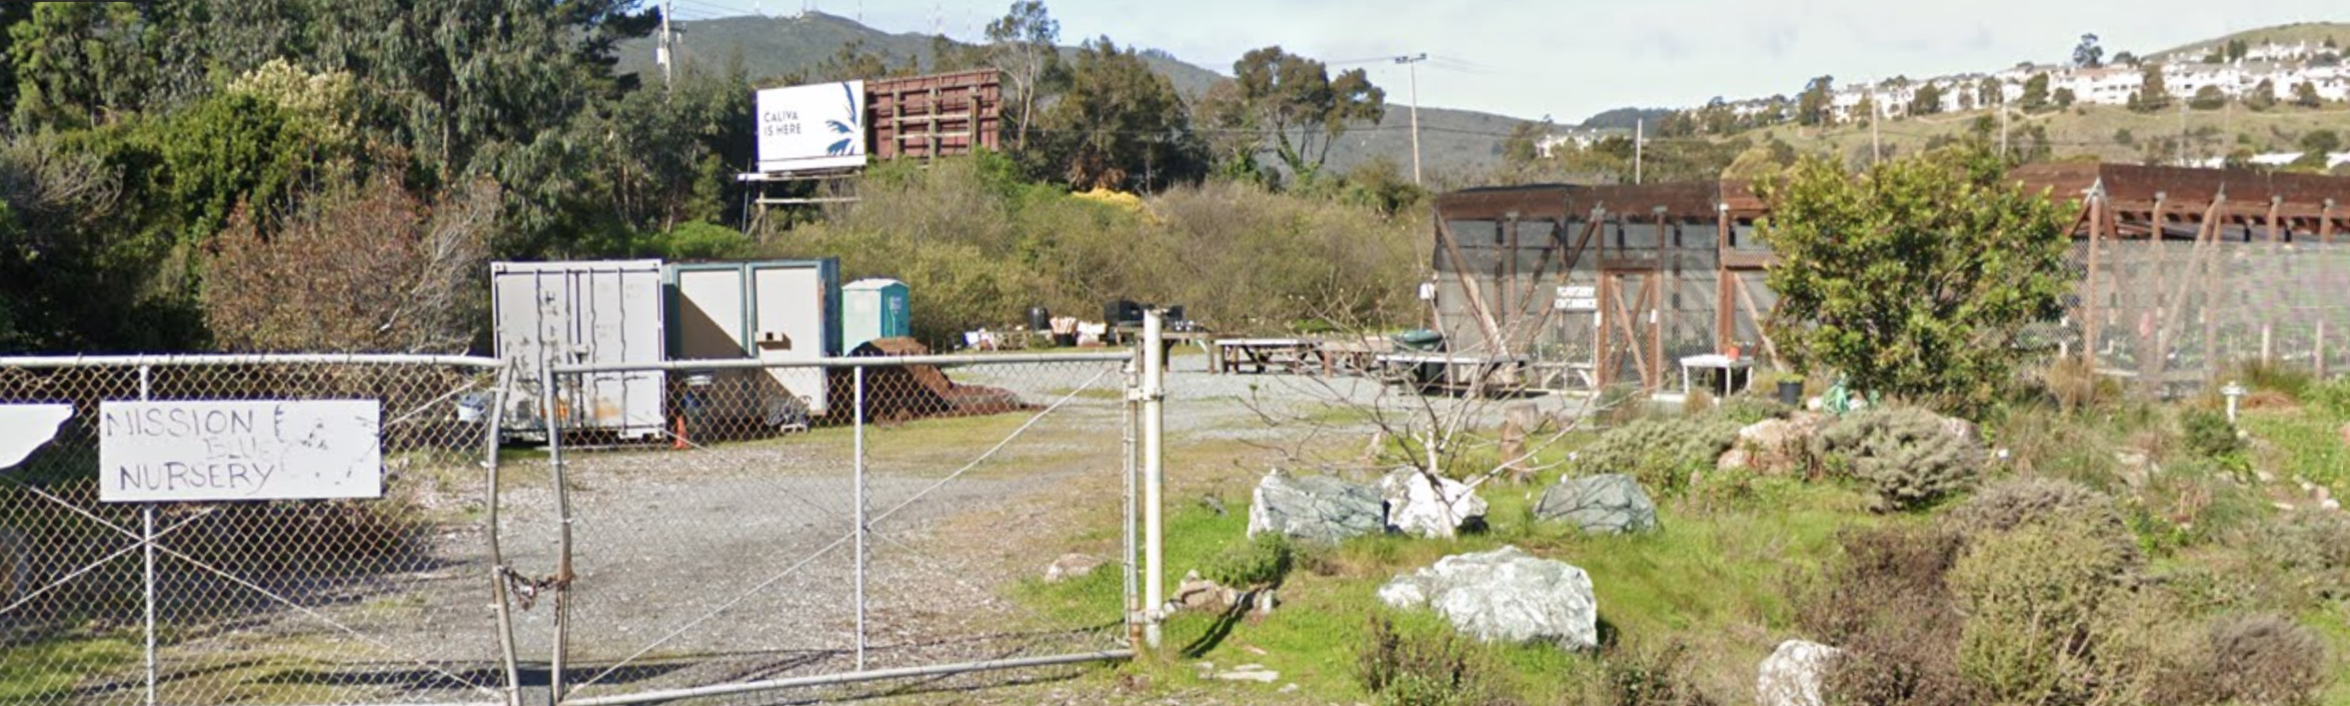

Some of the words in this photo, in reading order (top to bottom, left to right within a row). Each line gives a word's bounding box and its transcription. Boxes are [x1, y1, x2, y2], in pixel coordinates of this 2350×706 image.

[763, 110, 799, 123] CALIVA
[763, 125, 774, 137] IS
[776, 123, 802, 135] HERE
[106, 407, 254, 438] MISSION
[120, 461, 275, 496] NURSERY
